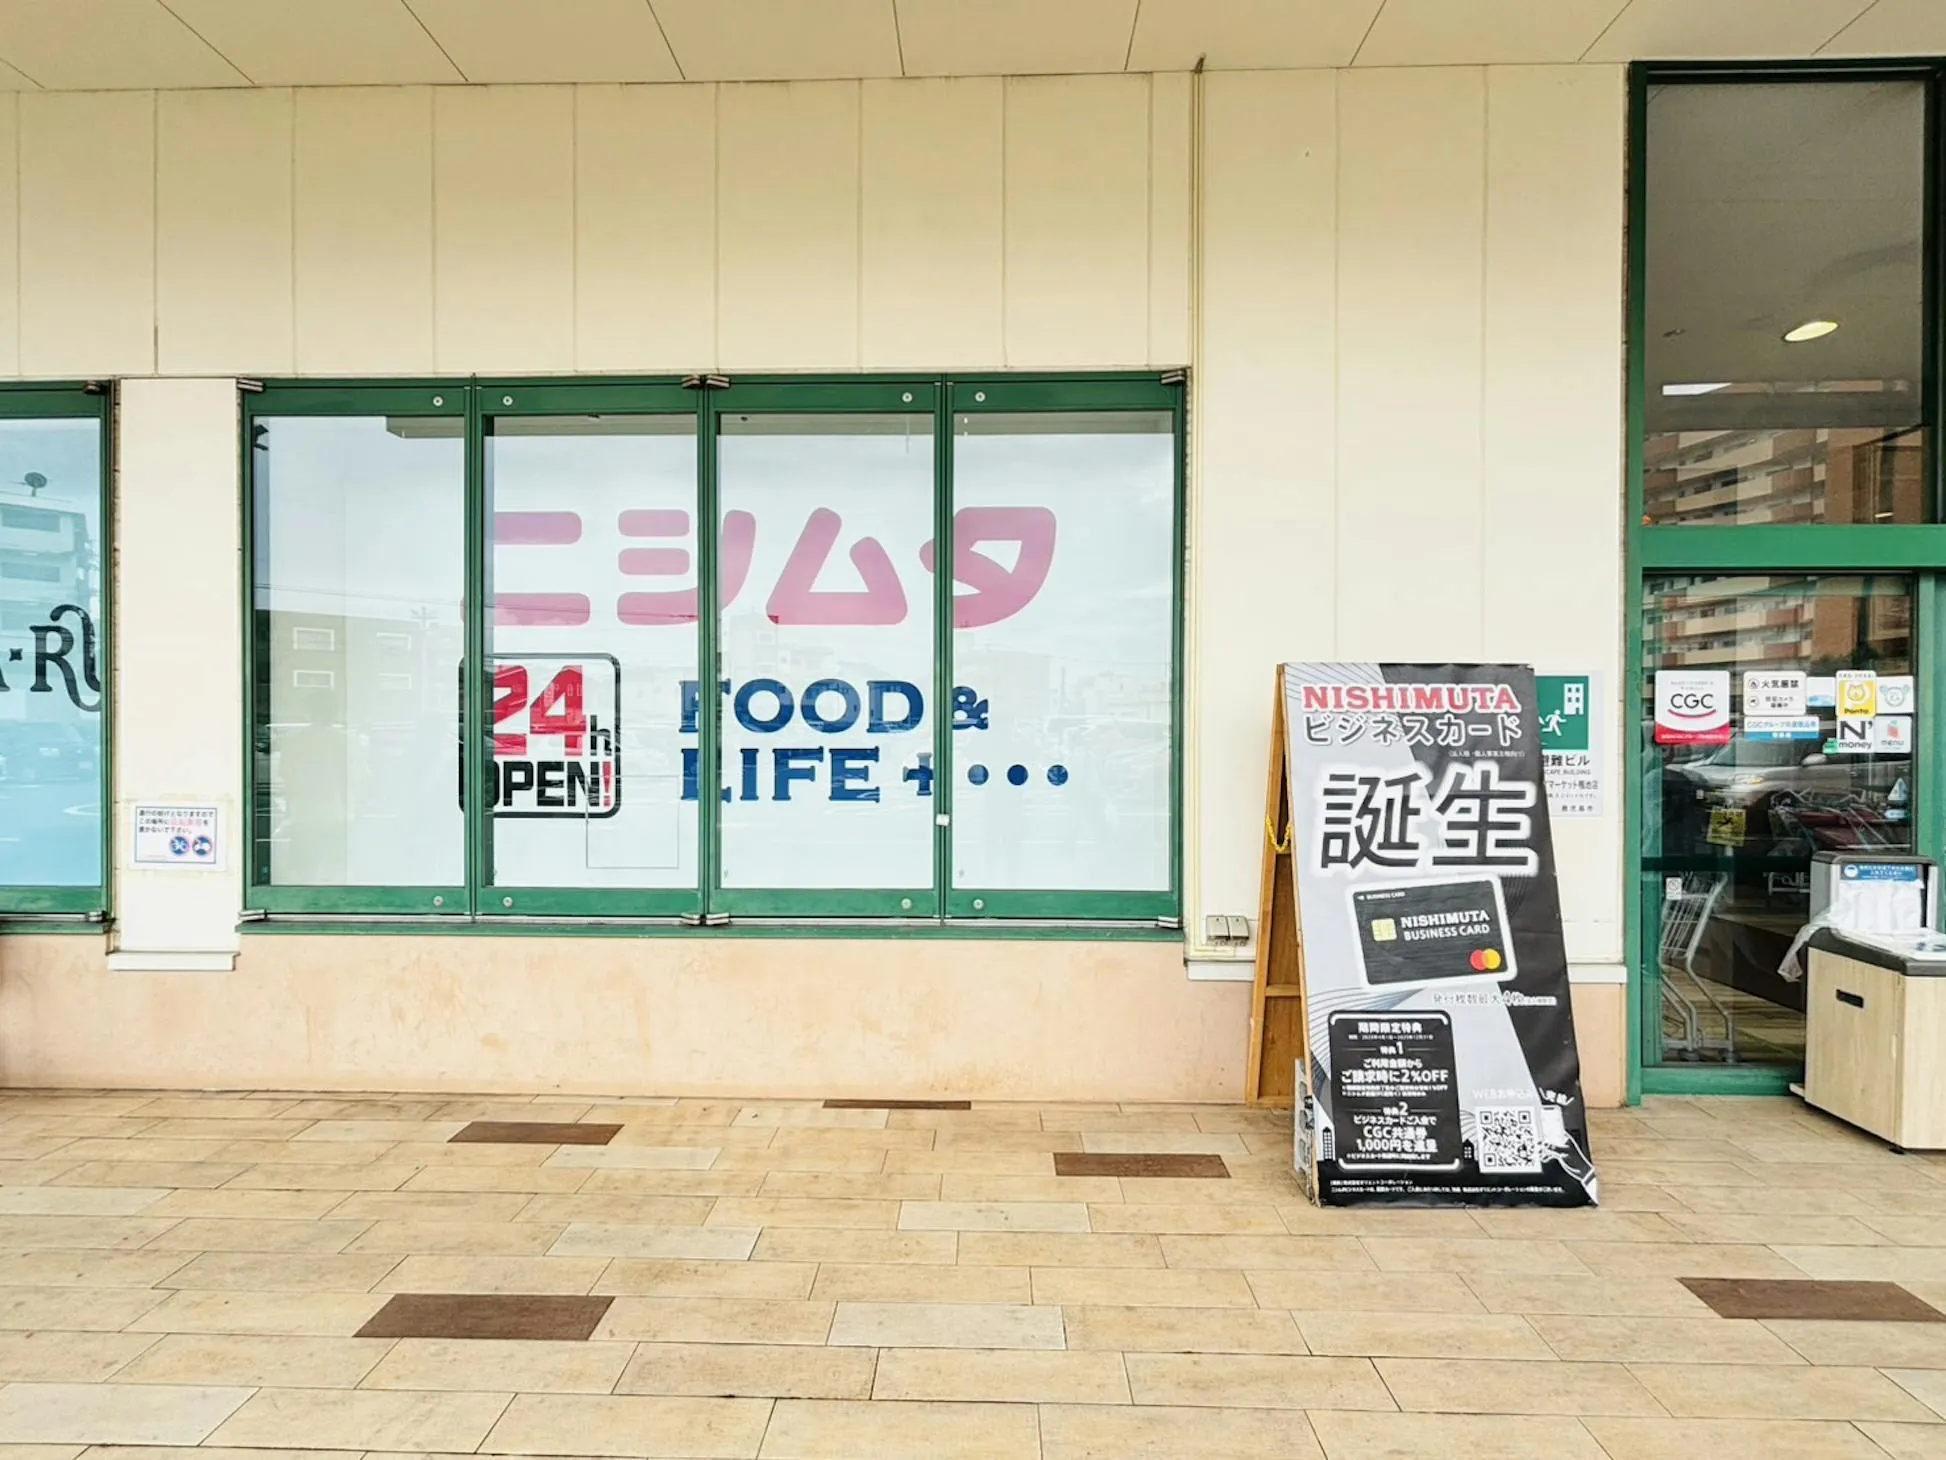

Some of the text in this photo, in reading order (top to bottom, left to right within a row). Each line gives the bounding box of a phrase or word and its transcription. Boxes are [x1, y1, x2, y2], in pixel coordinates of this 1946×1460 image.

[461, 507, 1057, 628] ニシムタ
[678, 678, 989, 734] FOOD &
[1302, 685, 1519, 711] NISHIMUTA
[1671, 693, 1714, 709] CGC
[1304, 715, 1521, 746] ビジネスカード
[1839, 741, 1872, 750] money
[681, 746, 881, 803] LIFE
[1321, 769, 1530, 870] 誕生
[1401, 910, 1490, 929] NISHIMUTA
[1403, 923, 1490, 941] BUSINESS CARD
